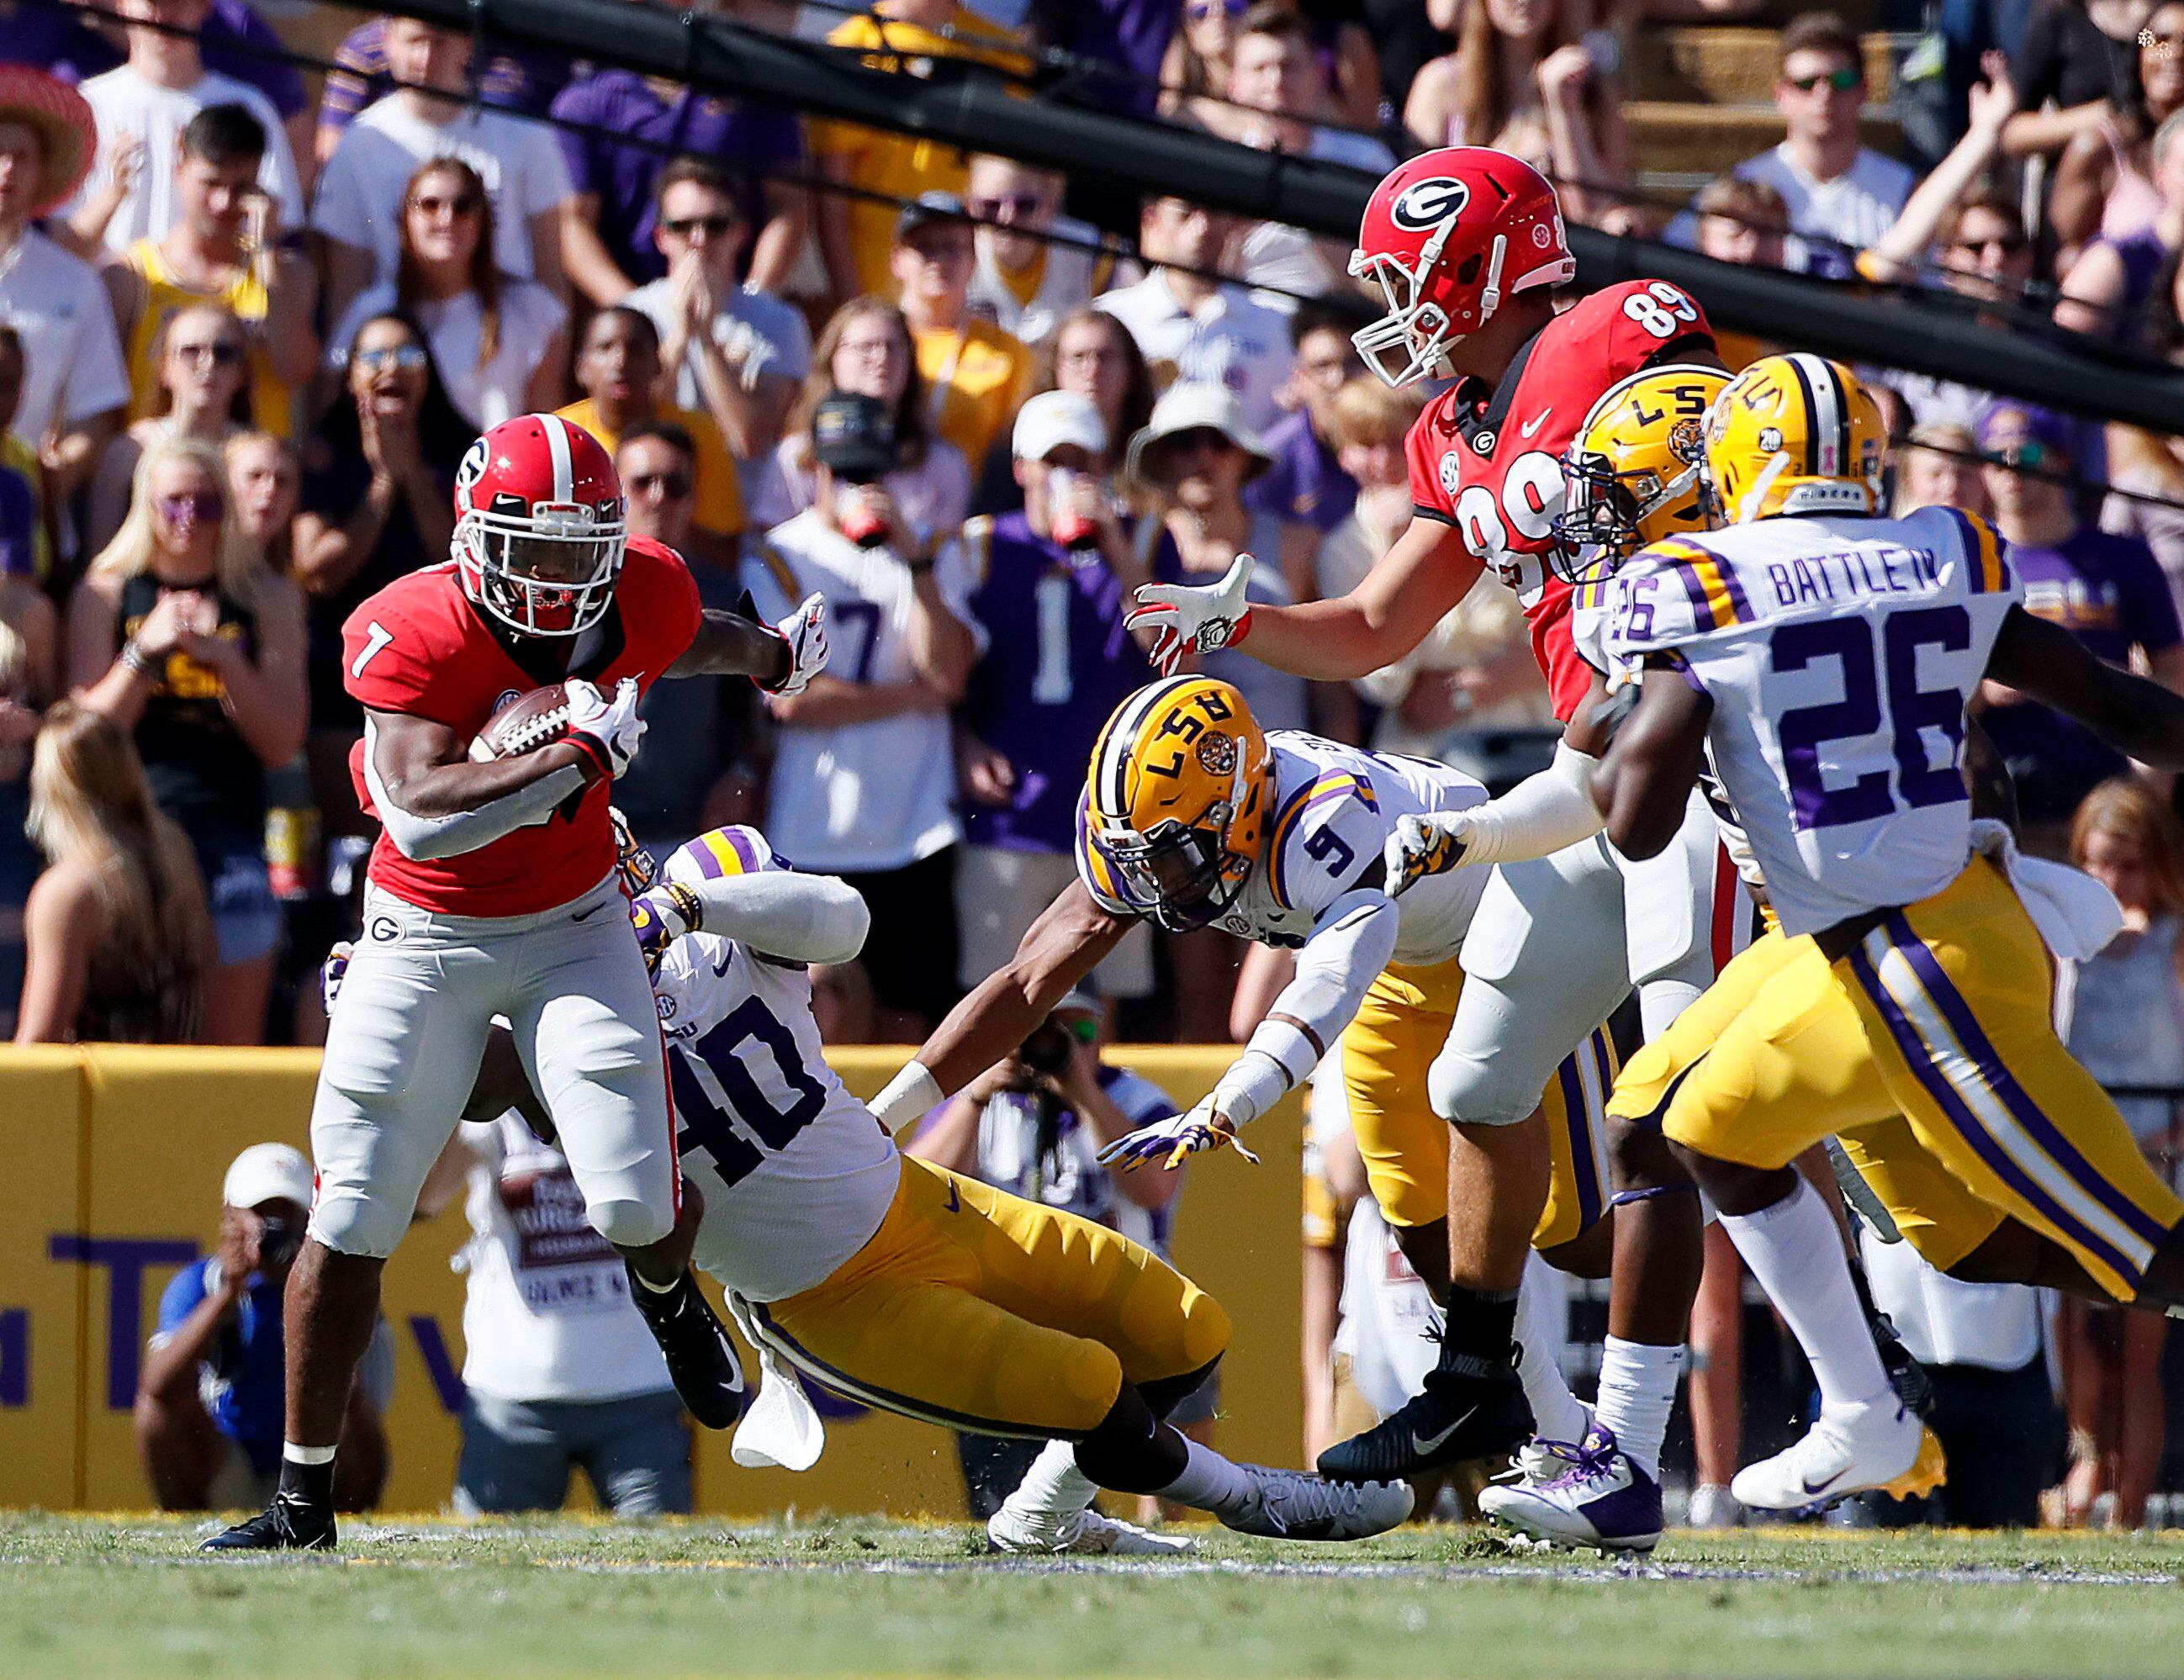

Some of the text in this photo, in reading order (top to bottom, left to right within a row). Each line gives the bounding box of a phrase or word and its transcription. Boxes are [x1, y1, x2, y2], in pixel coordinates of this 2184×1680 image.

[1392, 177, 1469, 232] G
[1622, 282, 1698, 338] 89
[1631, 385, 1706, 427] LS
[1473, 431, 1495, 454] G
[1769, 549, 1908, 606] BATTLE
[351, 621, 394, 679] 7
[834, 602, 879, 684] 7
[1032, 578, 1074, 705] 1
[1145, 690, 1233, 780] LSU
[1769, 605, 1970, 829] 26
[1304, 822, 1355, 879] 9
[372, 917, 399, 942] G
[668, 993, 828, 1188] 40
